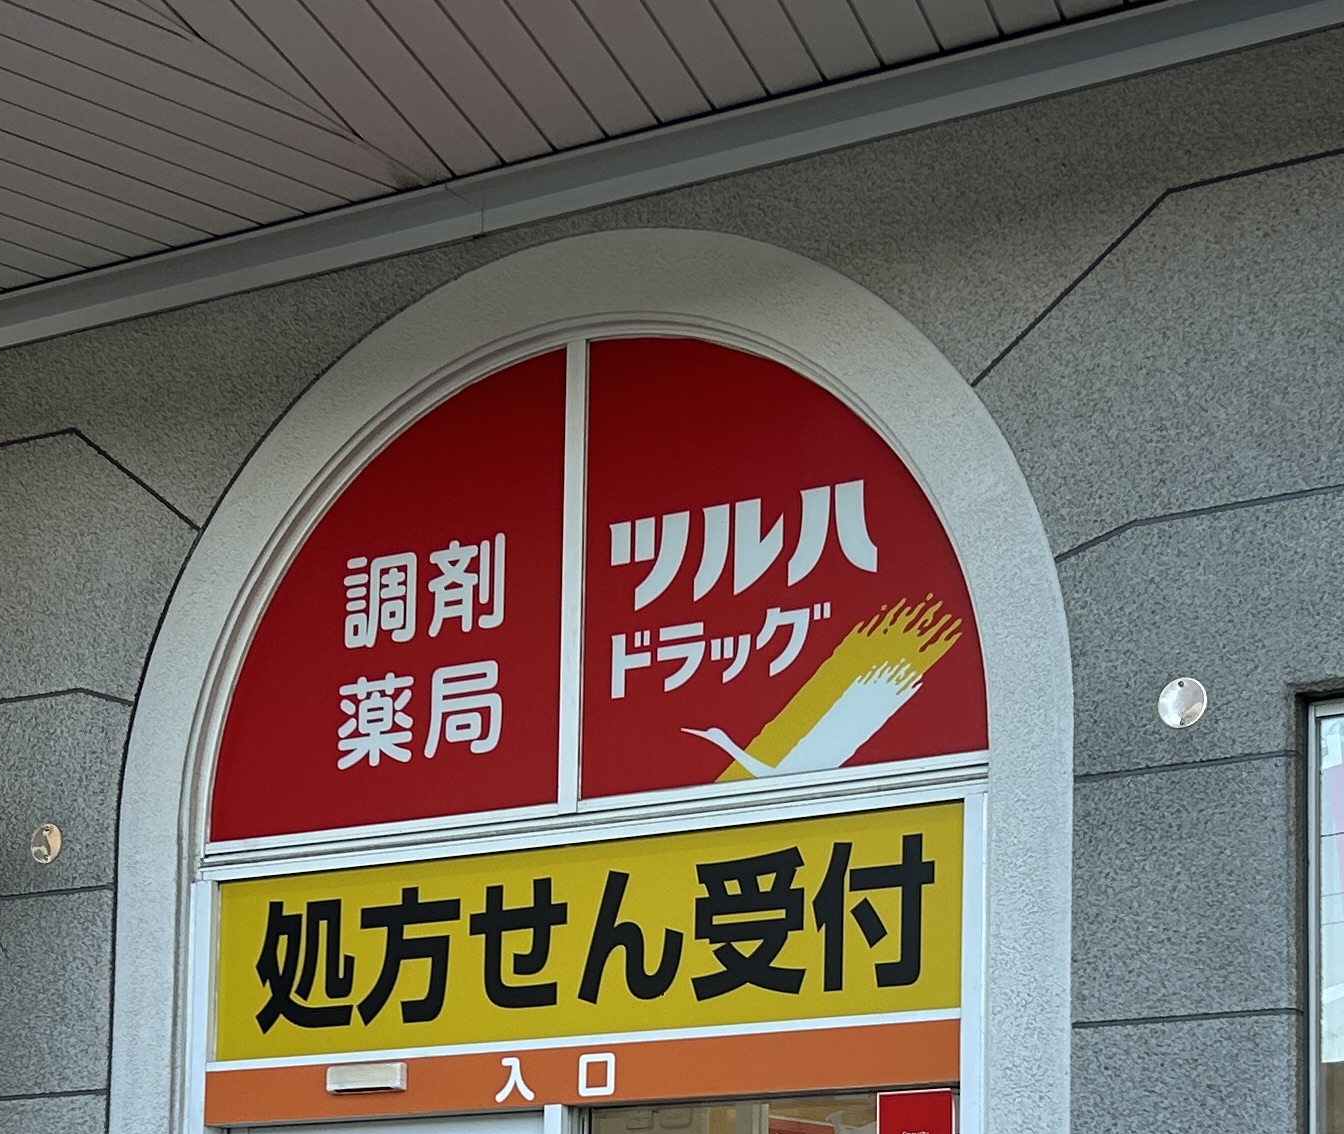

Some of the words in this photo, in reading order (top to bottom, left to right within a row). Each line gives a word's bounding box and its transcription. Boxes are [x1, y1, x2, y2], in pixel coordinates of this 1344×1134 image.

[343, 531, 506, 650] 調剤
[609, 479, 878, 613] ツルハ
[610, 600, 832, 699] ドラッグ
[337, 659, 504, 772] 薬局
[255, 831, 936, 1036] 処方せん受付
[494, 1052, 617, 1104] 入口
